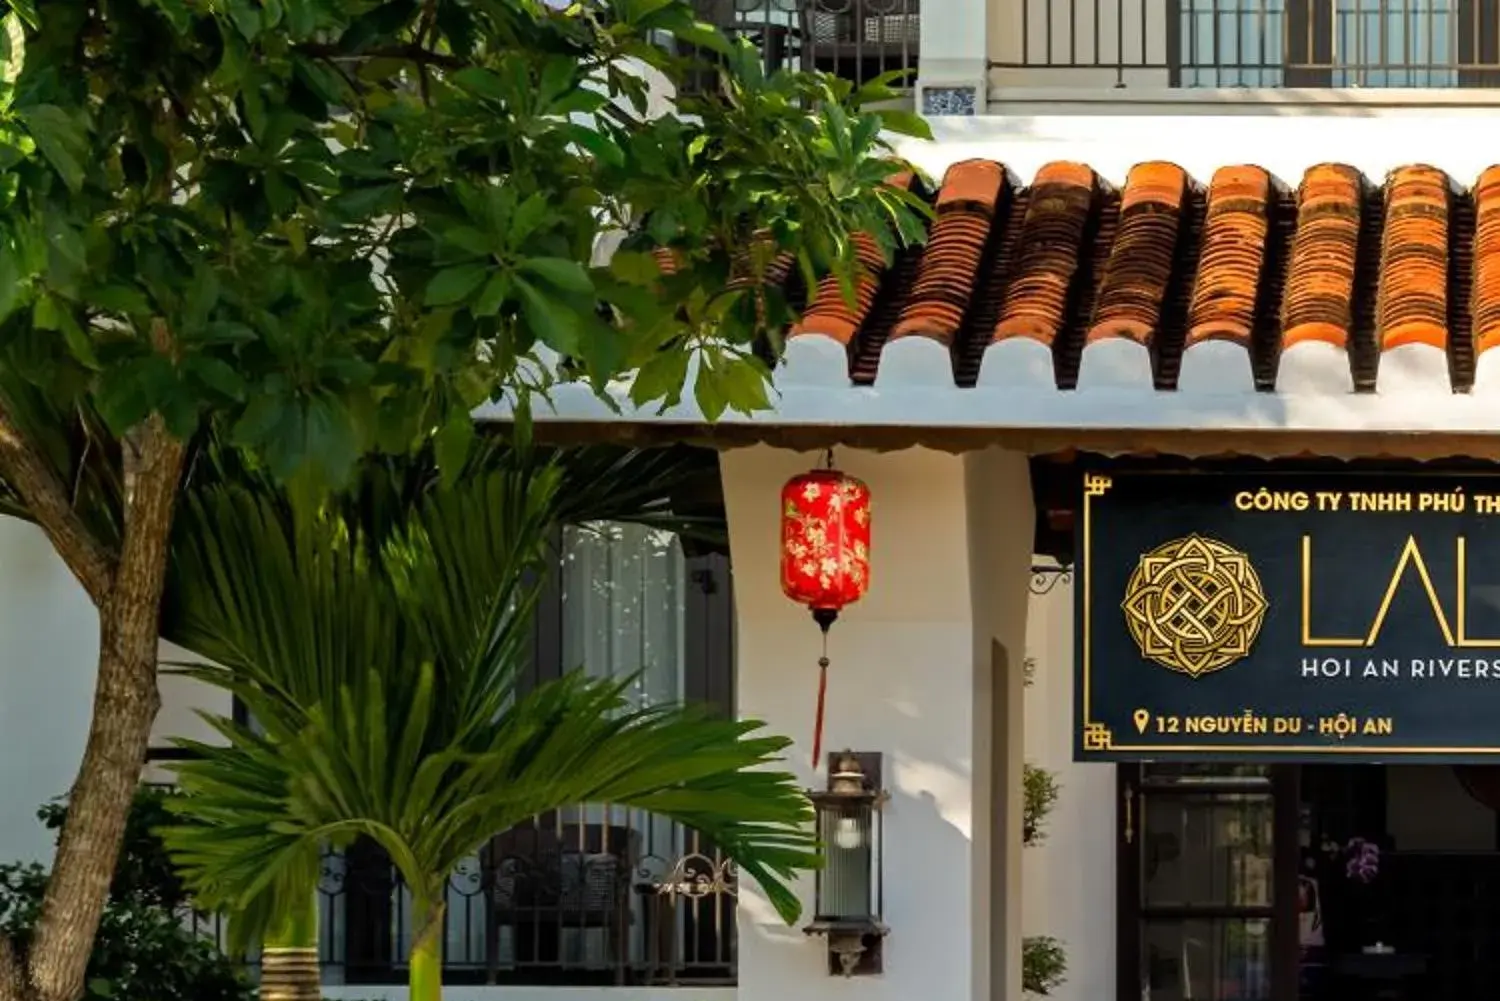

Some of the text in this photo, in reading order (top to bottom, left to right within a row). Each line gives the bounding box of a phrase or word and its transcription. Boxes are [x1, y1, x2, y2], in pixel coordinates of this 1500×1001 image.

[1235, 486, 1310, 511] CÔNG
[1315, 492, 1342, 511] TY
[1348, 492, 1411, 511] TNHH
[1418, 486, 1465, 512] PHÚ
[1301, 658, 1351, 677] HOI
[1363, 658, 1400, 677] AN
[1156, 716, 1180, 734] 12
[1273, 717, 1302, 734] DU
[1319, 712, 1357, 739] HỘI
[1363, 717, 1393, 734] AN
